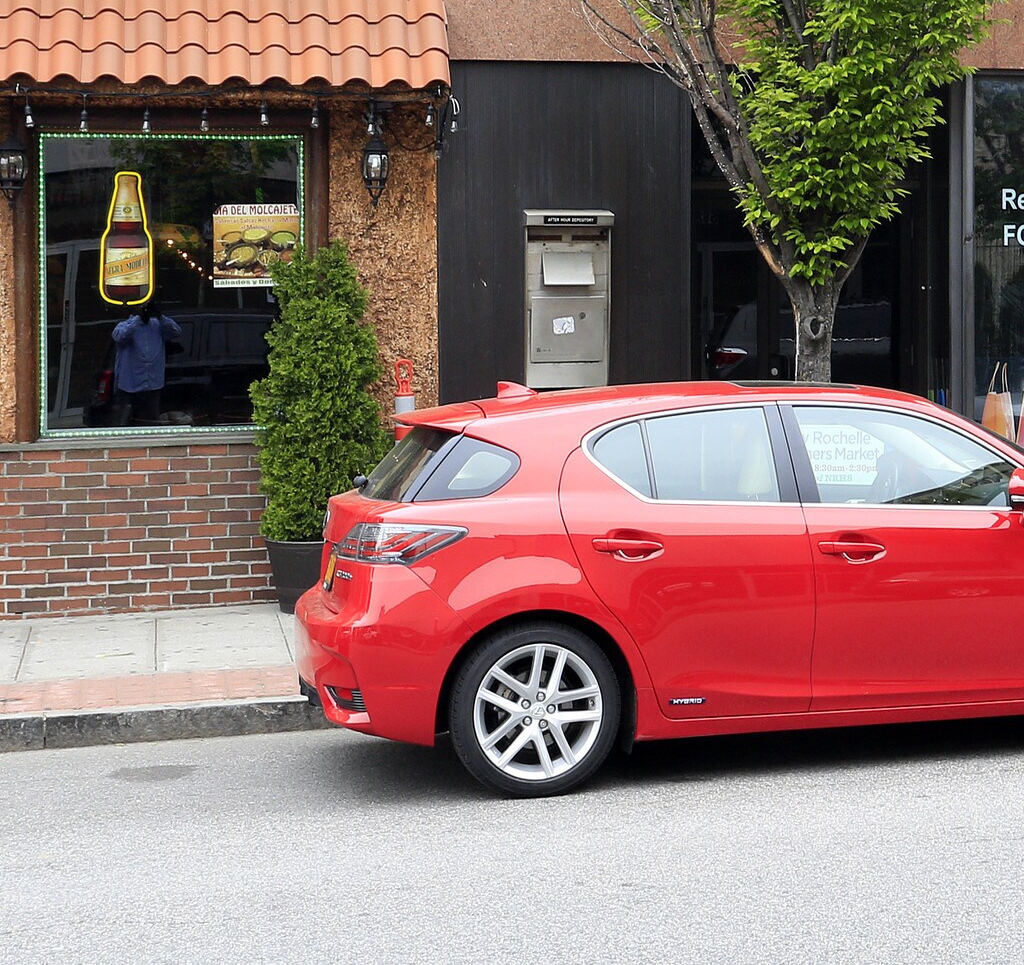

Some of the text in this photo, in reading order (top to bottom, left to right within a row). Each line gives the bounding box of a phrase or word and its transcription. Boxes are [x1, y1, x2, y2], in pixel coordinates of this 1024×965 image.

[231, 205, 247, 215] DEL
[813, 431, 871, 445] Rochelle
[835, 447, 880, 461] Market
[825, 474, 853, 482] NRHS
